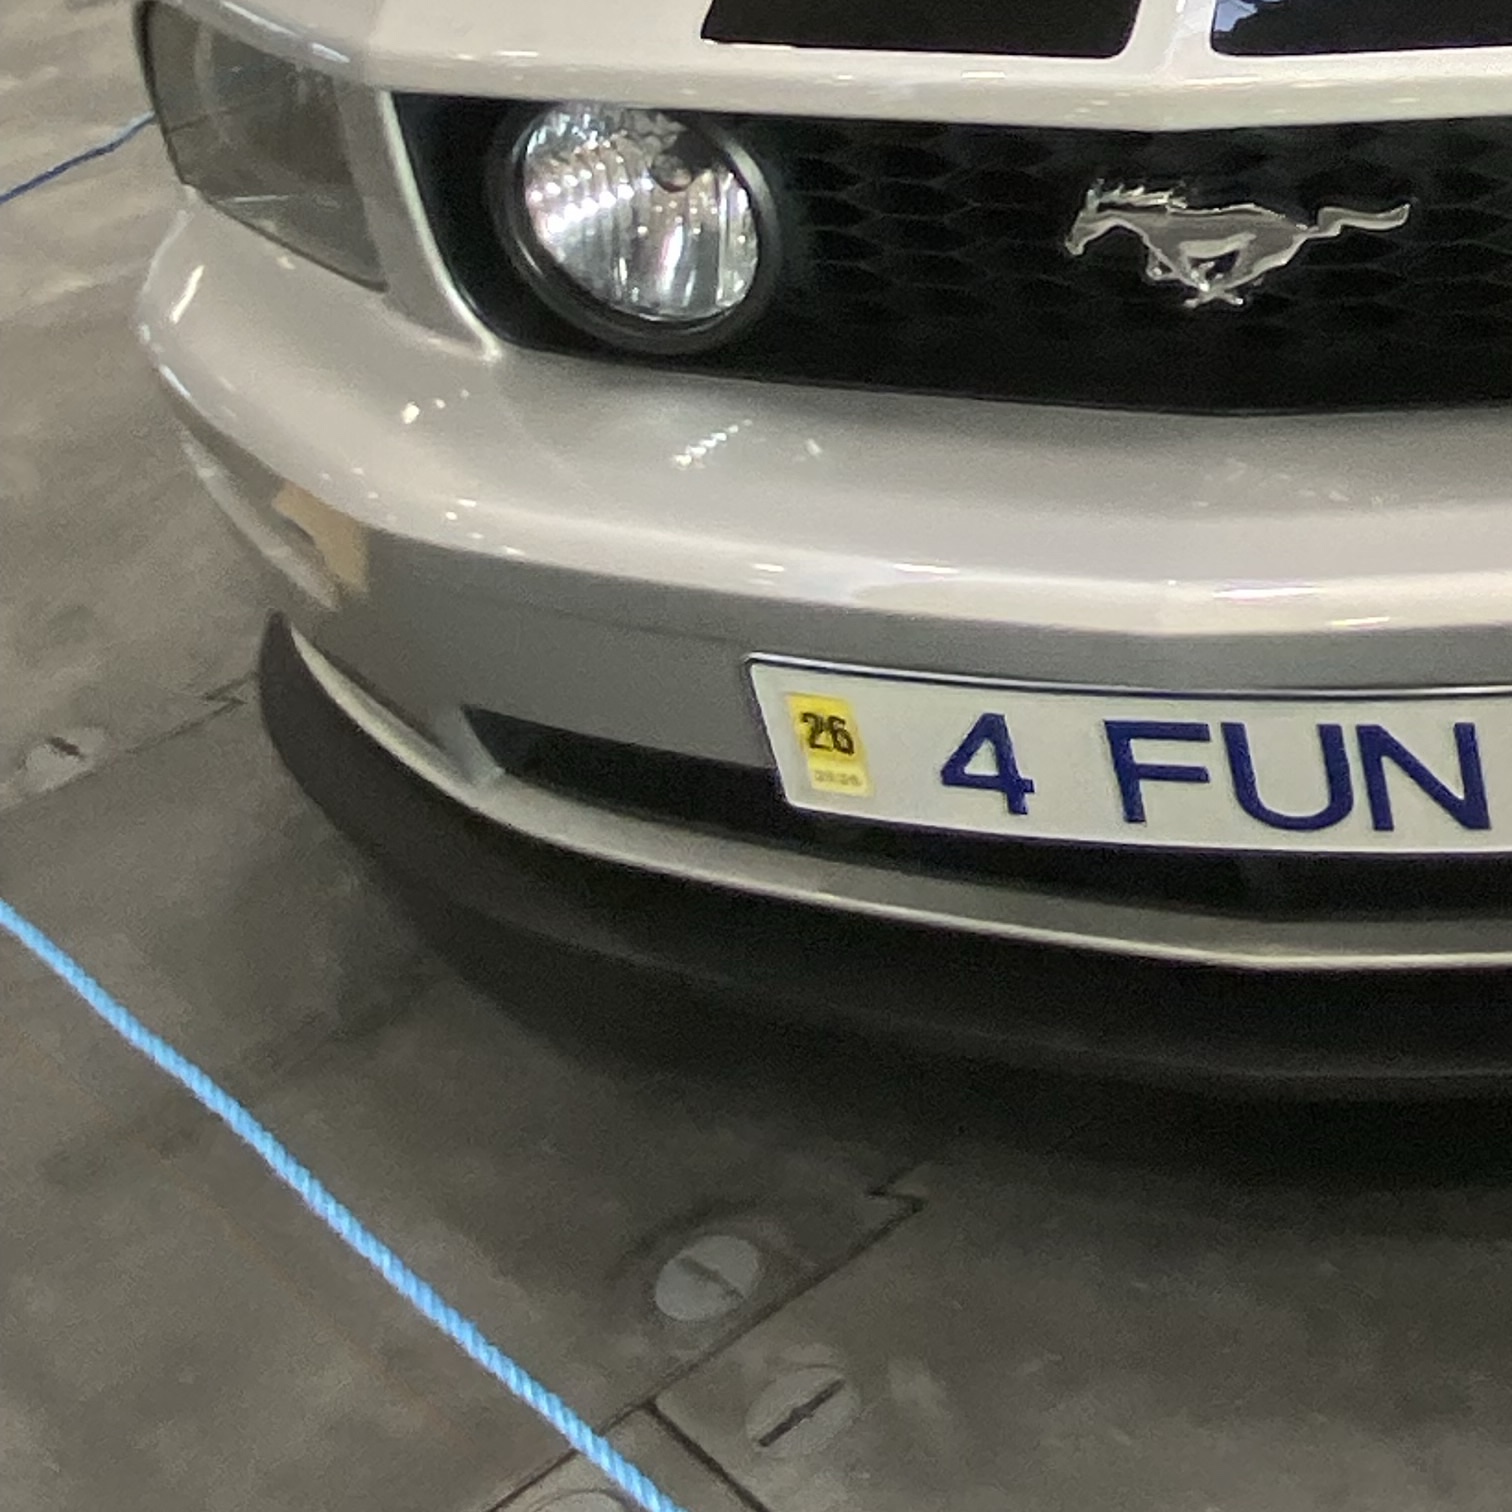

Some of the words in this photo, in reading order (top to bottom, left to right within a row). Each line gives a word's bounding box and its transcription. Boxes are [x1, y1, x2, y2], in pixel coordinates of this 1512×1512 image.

[801, 712, 855, 756] 26
[940, 712, 1035, 816] 4
[1103, 720, 1492, 831] FUN
